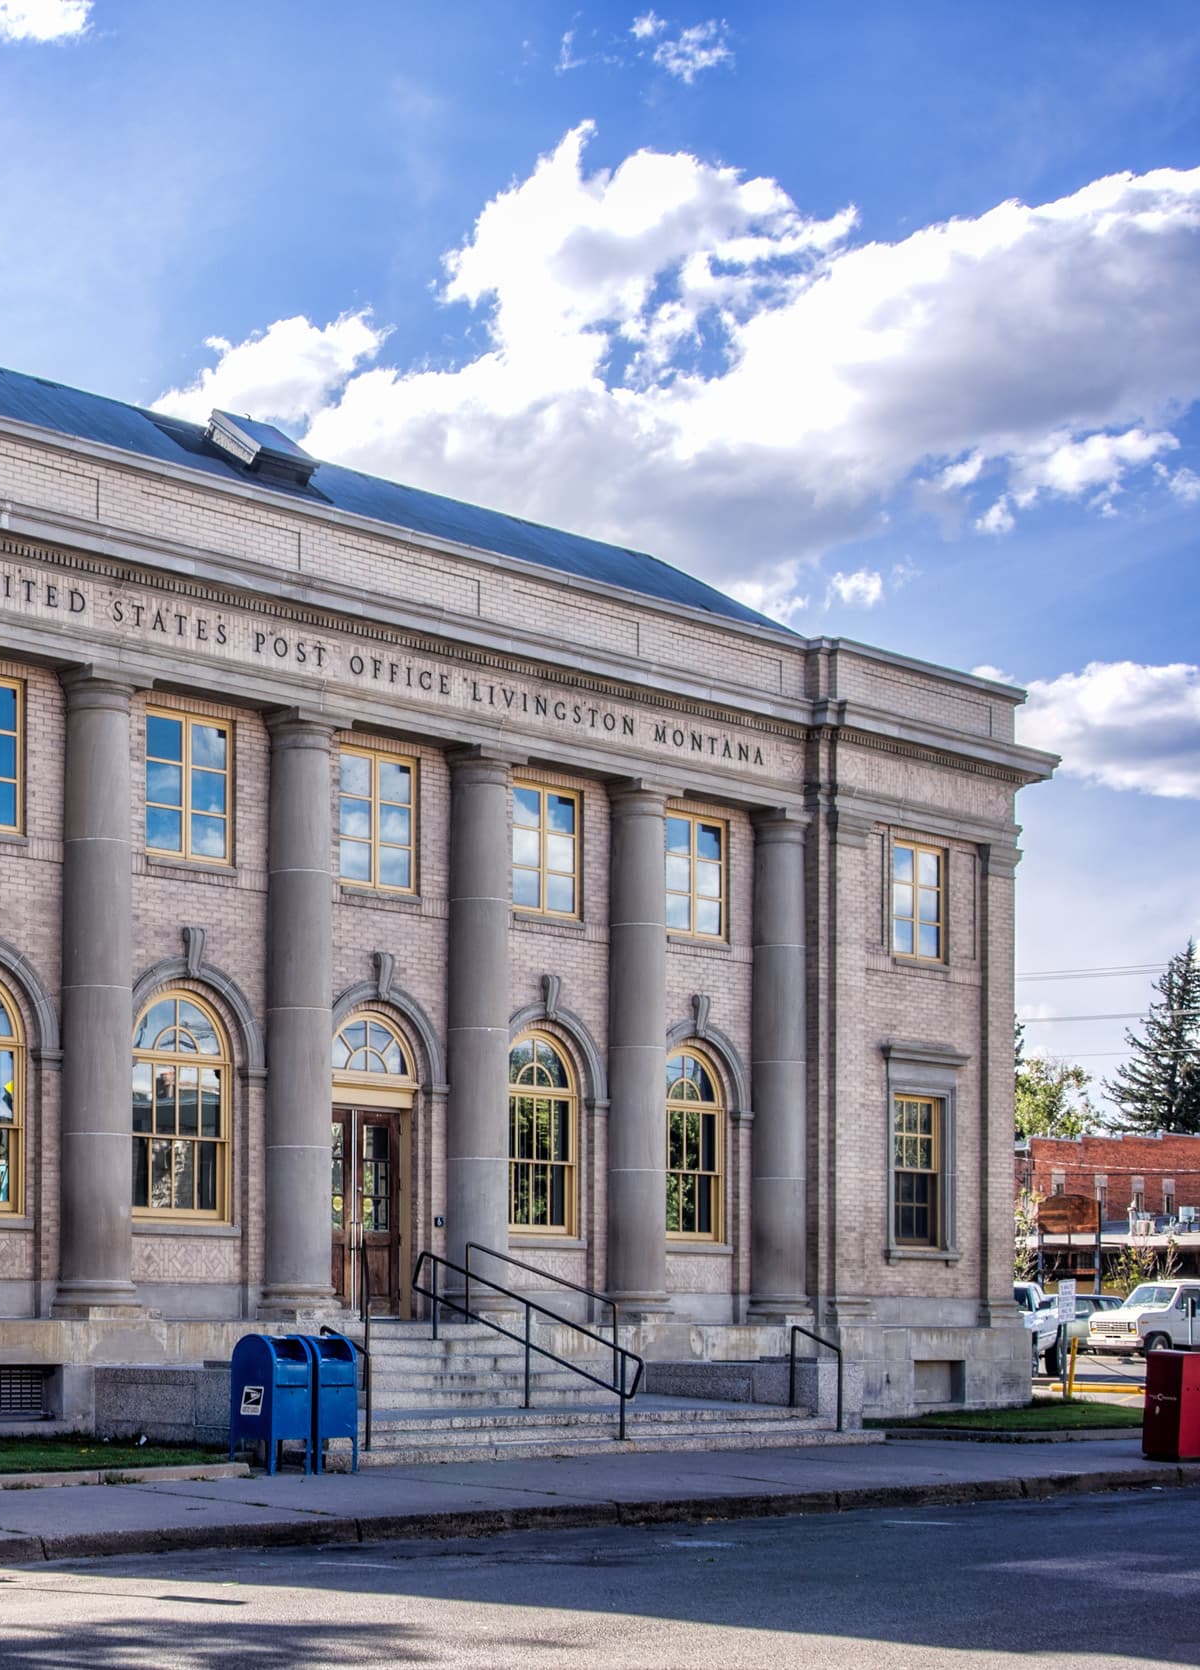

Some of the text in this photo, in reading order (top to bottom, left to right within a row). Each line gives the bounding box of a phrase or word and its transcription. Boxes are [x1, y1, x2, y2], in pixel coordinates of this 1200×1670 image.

[113, 600, 227, 645] STATES
[255, 632, 326, 667] POST
[350, 655, 449, 694] OFFICE
[472, 682, 634, 736] LIVINGSTON
[654, 724, 764, 765] MONTANA
